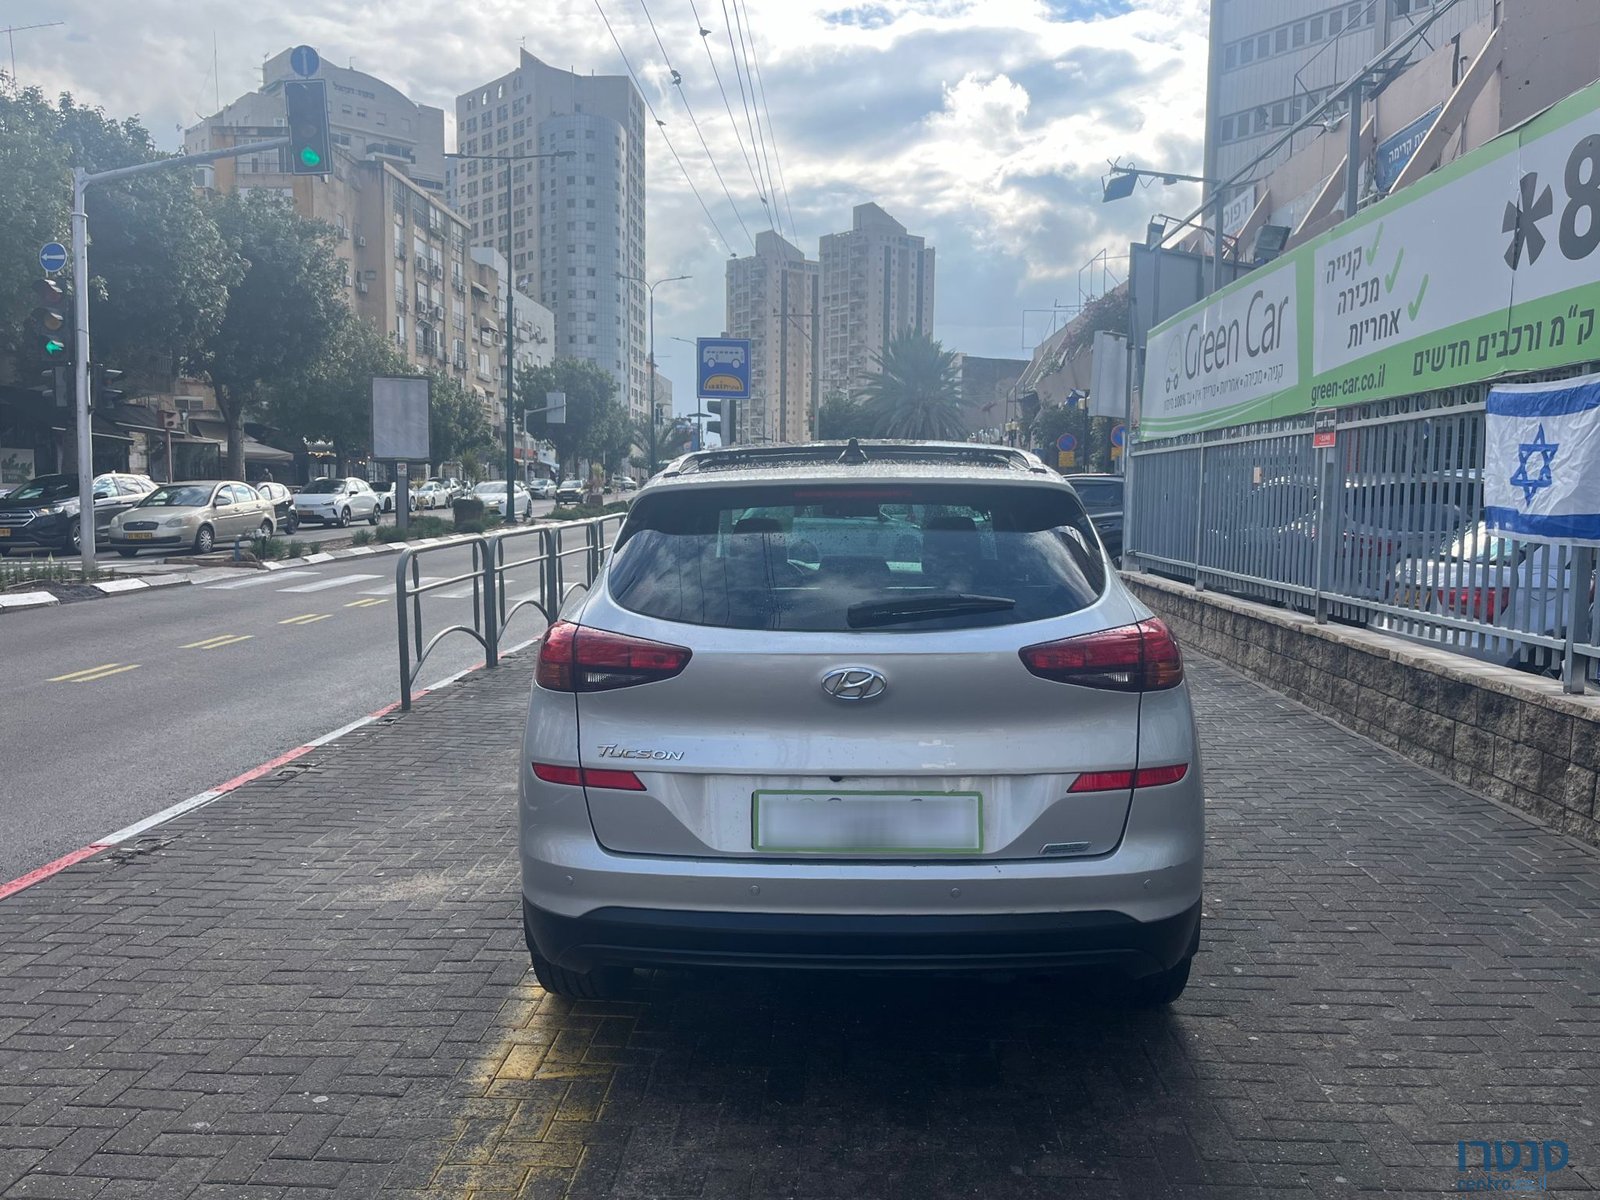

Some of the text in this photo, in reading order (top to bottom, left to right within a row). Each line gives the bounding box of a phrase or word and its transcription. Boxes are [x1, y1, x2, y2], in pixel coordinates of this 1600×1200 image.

[1325, 246, 1363, 284] קנייה
[1337, 276, 1380, 316] מכירה
[1184, 290, 1289, 380] Green Car
[1347, 307, 1401, 349] אחריות
[1475, 321, 1542, 363] ורכבים
[1267, 363, 1284, 383] קניה
[1412, 340, 1470, 376] חדשים
[1310, 363, 1386, 407] green-car.co.il
[597, 743, 685, 761] TUCSON
